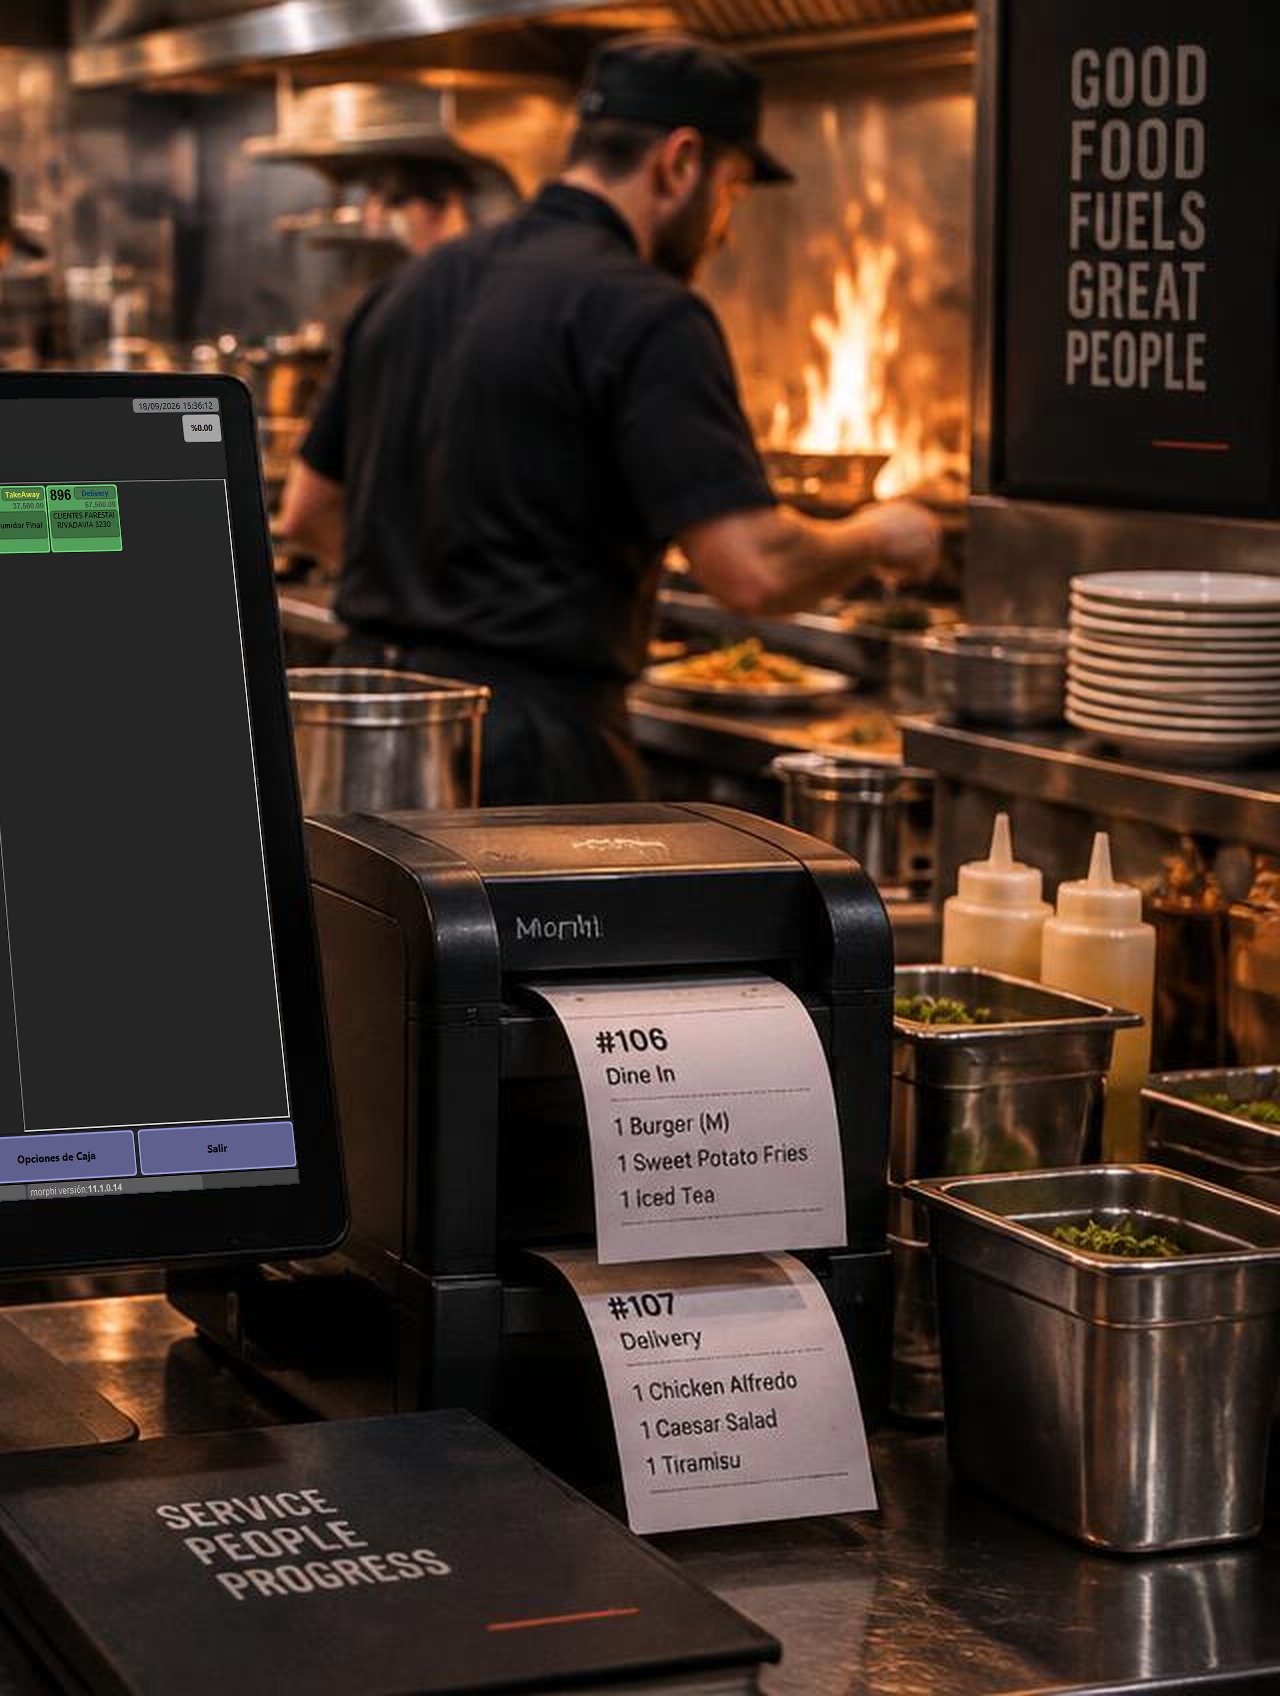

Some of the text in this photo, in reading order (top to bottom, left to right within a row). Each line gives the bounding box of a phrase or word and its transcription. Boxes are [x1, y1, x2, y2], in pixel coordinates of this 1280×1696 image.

[1071, 45, 1207, 110] GOOD
[1071, 118, 1206, 181] FOOD
[1069, 190, 1206, 251] FUELS
[1067, 260, 1206, 321] GREAT
[1065, 329, 1207, 391] PEOPLE
[191, 424, 212, 432] %0.00
[50, 489, 71, 500] 896
[82, 490, 109, 498] Delivery
[596, 1028, 668, 1054] #106
[606, 1065, 676, 1086] Dine In
[614, 1112, 730, 1138] 1 Burger (M)
[17, 1151, 96, 1165] Opciones de Caja
[207, 1144, 228, 1154] Salir
[618, 1146, 808, 1172] 1 Sweet Potato Fries
[30, 1187, 57, 1198] morphi
[620, 1186, 715, 1208] 1 Iced Tea
[608, 1293, 676, 1320] #107
[620, 1329, 702, 1351] Delivery
[632, 1371, 797, 1402] 1 Chicken Alfredo
[640, 1408, 778, 1439] 1 Caesar Salad
[647, 1452, 741, 1475] 1 Tiramisu
[155, 1489, 338, 1530] SERVICE
[184, 1520, 369, 1566] PEOPLE
[216, 1548, 452, 1600] PROGRESS
